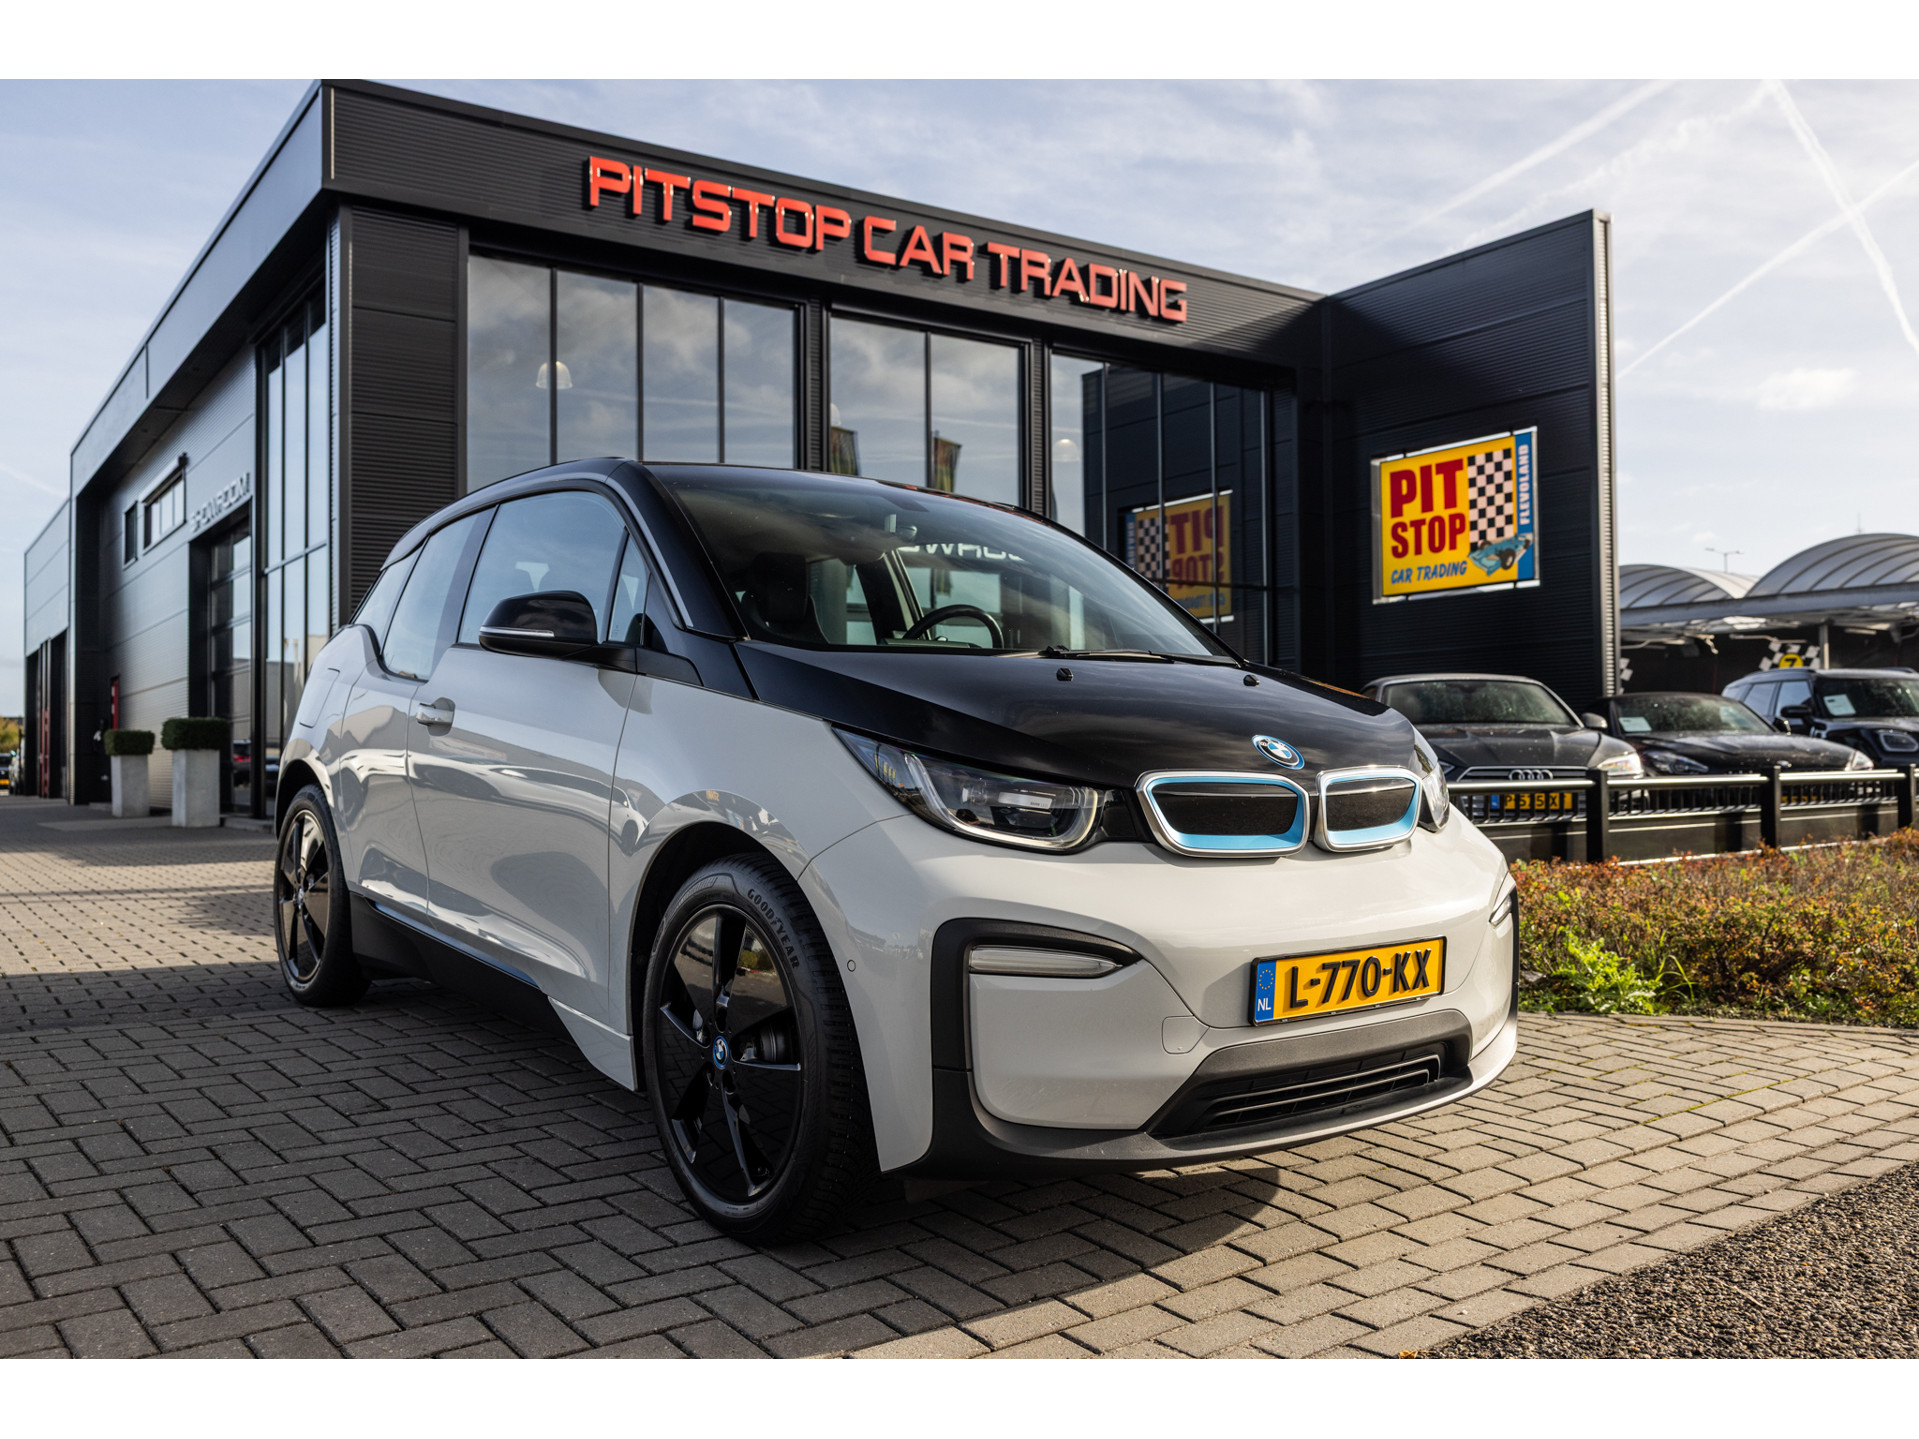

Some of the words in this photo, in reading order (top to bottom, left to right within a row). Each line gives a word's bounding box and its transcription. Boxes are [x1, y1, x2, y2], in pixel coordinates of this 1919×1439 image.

[589, 156, 851, 251] PITSTOP
[863, 216, 975, 281] CAR
[987, 241, 1188, 322] TRADING
[1390, 458, 1464, 518] PIT
[1518, 444, 1531, 525] FLEVOLAND
[1391, 513, 1466, 559] STOP
[1391, 569, 1413, 584] CAR
[1417, 561, 1467, 581] TRADING
[748, 889, 799, 968] GOODYEAR
[1258, 998, 1271, 1011] NL
[1290, 948, 1431, 1008] L-770-KX
